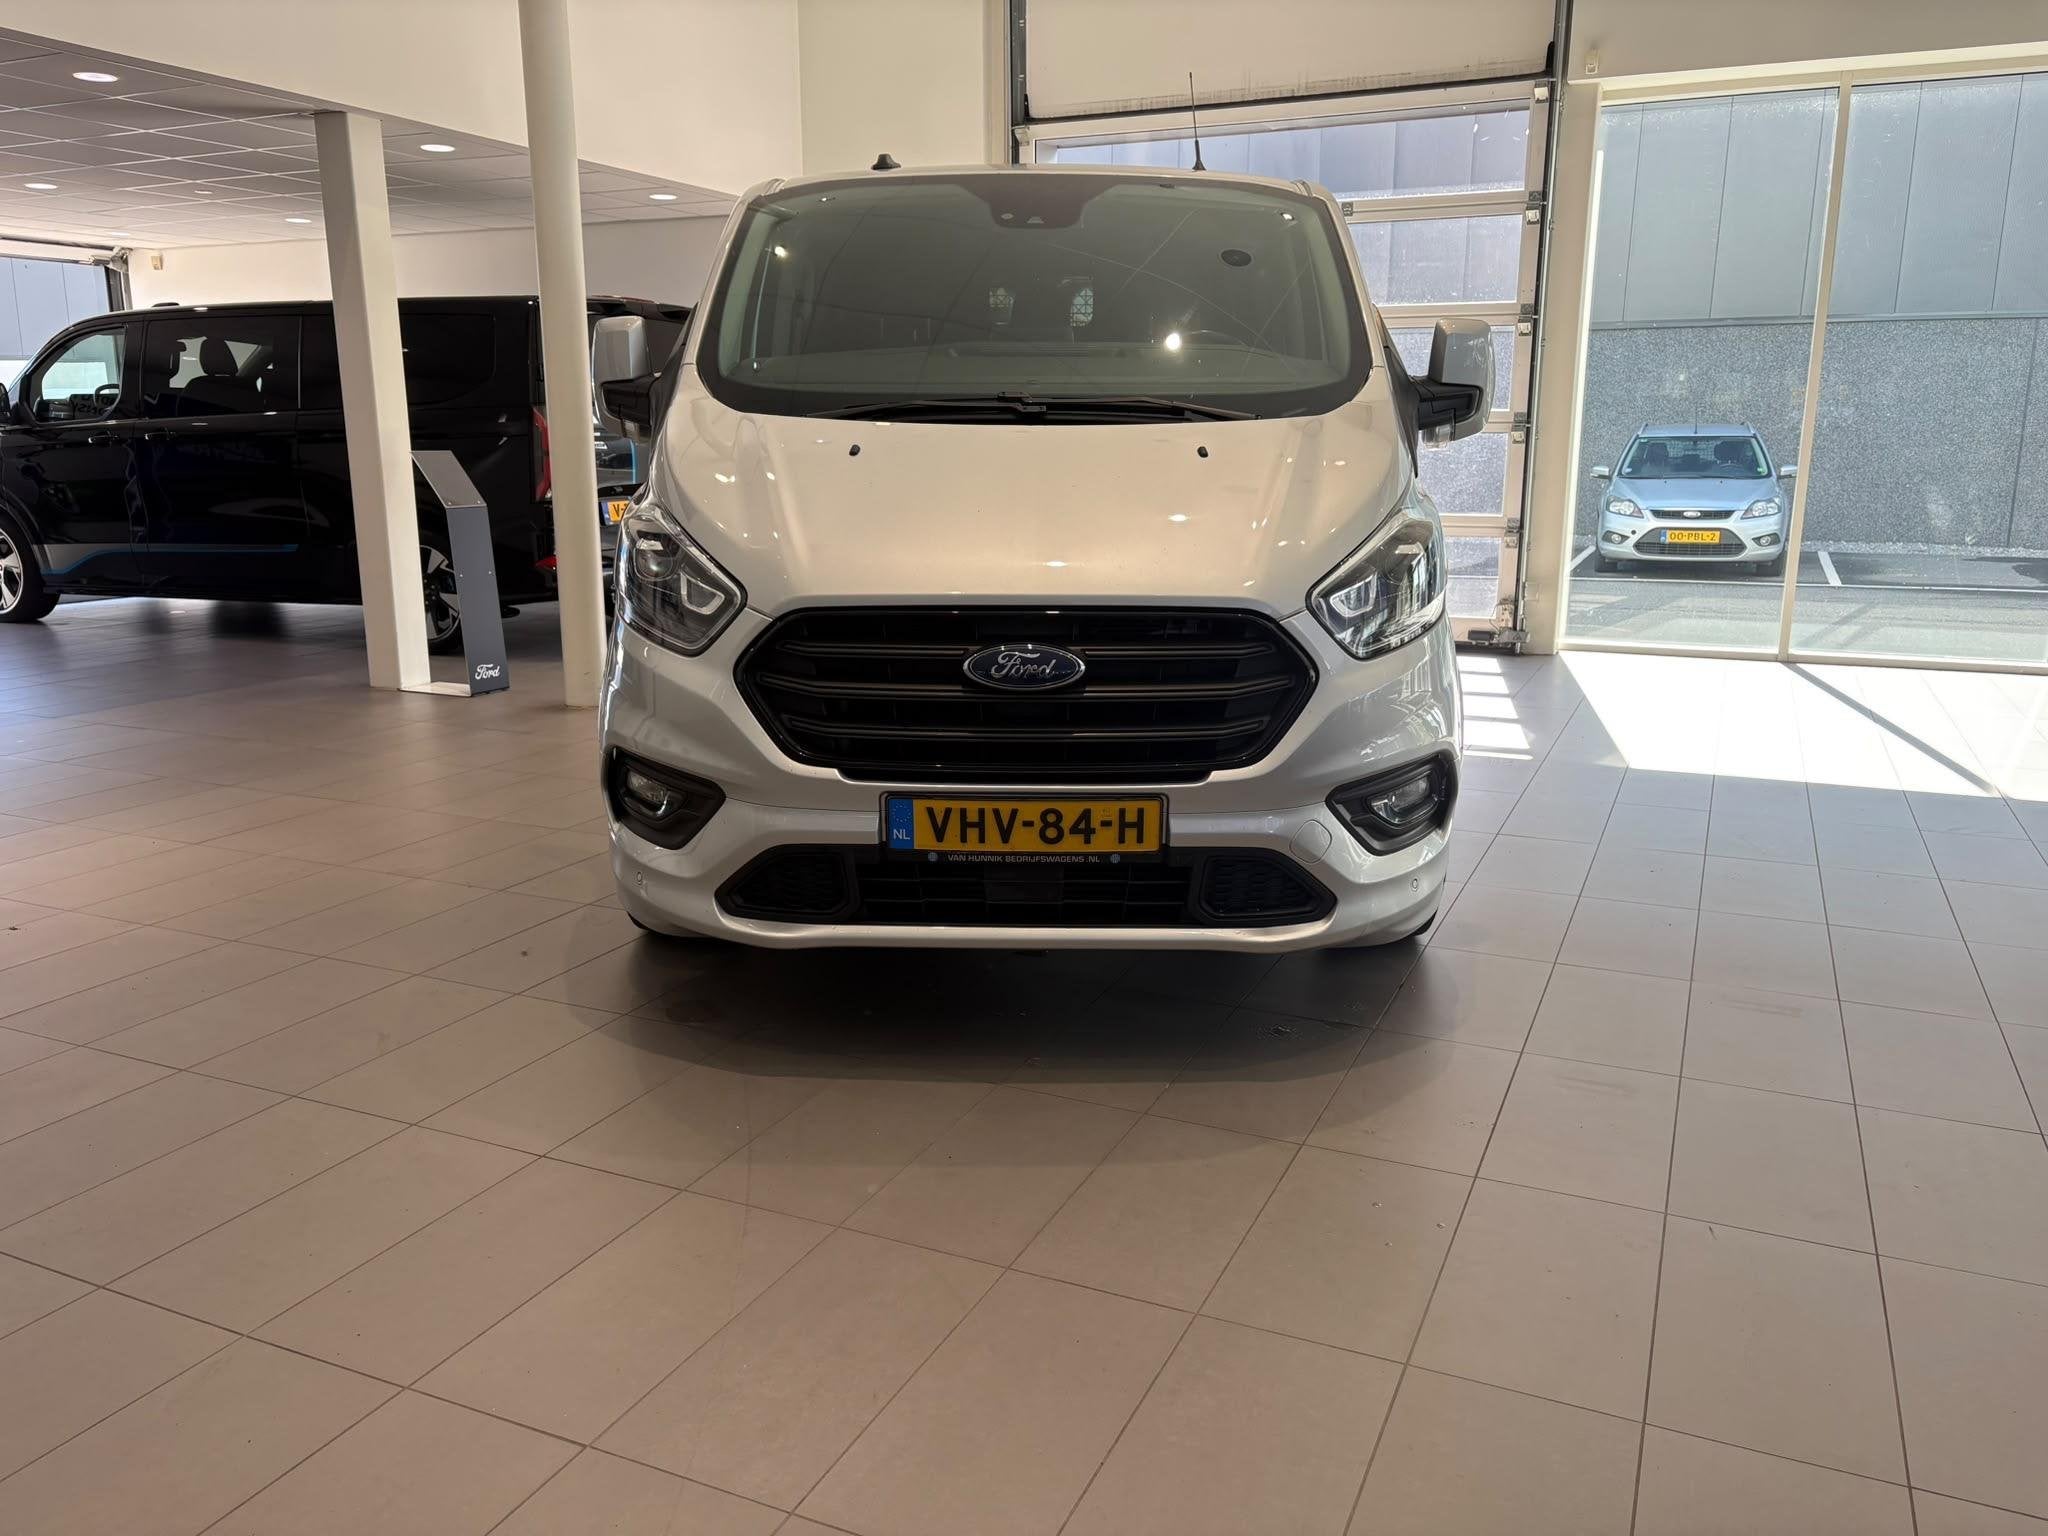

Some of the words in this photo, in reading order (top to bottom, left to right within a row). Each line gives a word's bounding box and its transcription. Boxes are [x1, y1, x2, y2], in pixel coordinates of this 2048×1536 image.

[475, 663, 501, 680] Ford
[991, 651, 1057, 679] Ford
[893, 828, 911, 840] NL
[925, 806, 1145, 845] VHV-84-H
[947, 854, 967, 863] VAN
[968, 854, 1004, 863] HUNNIK
